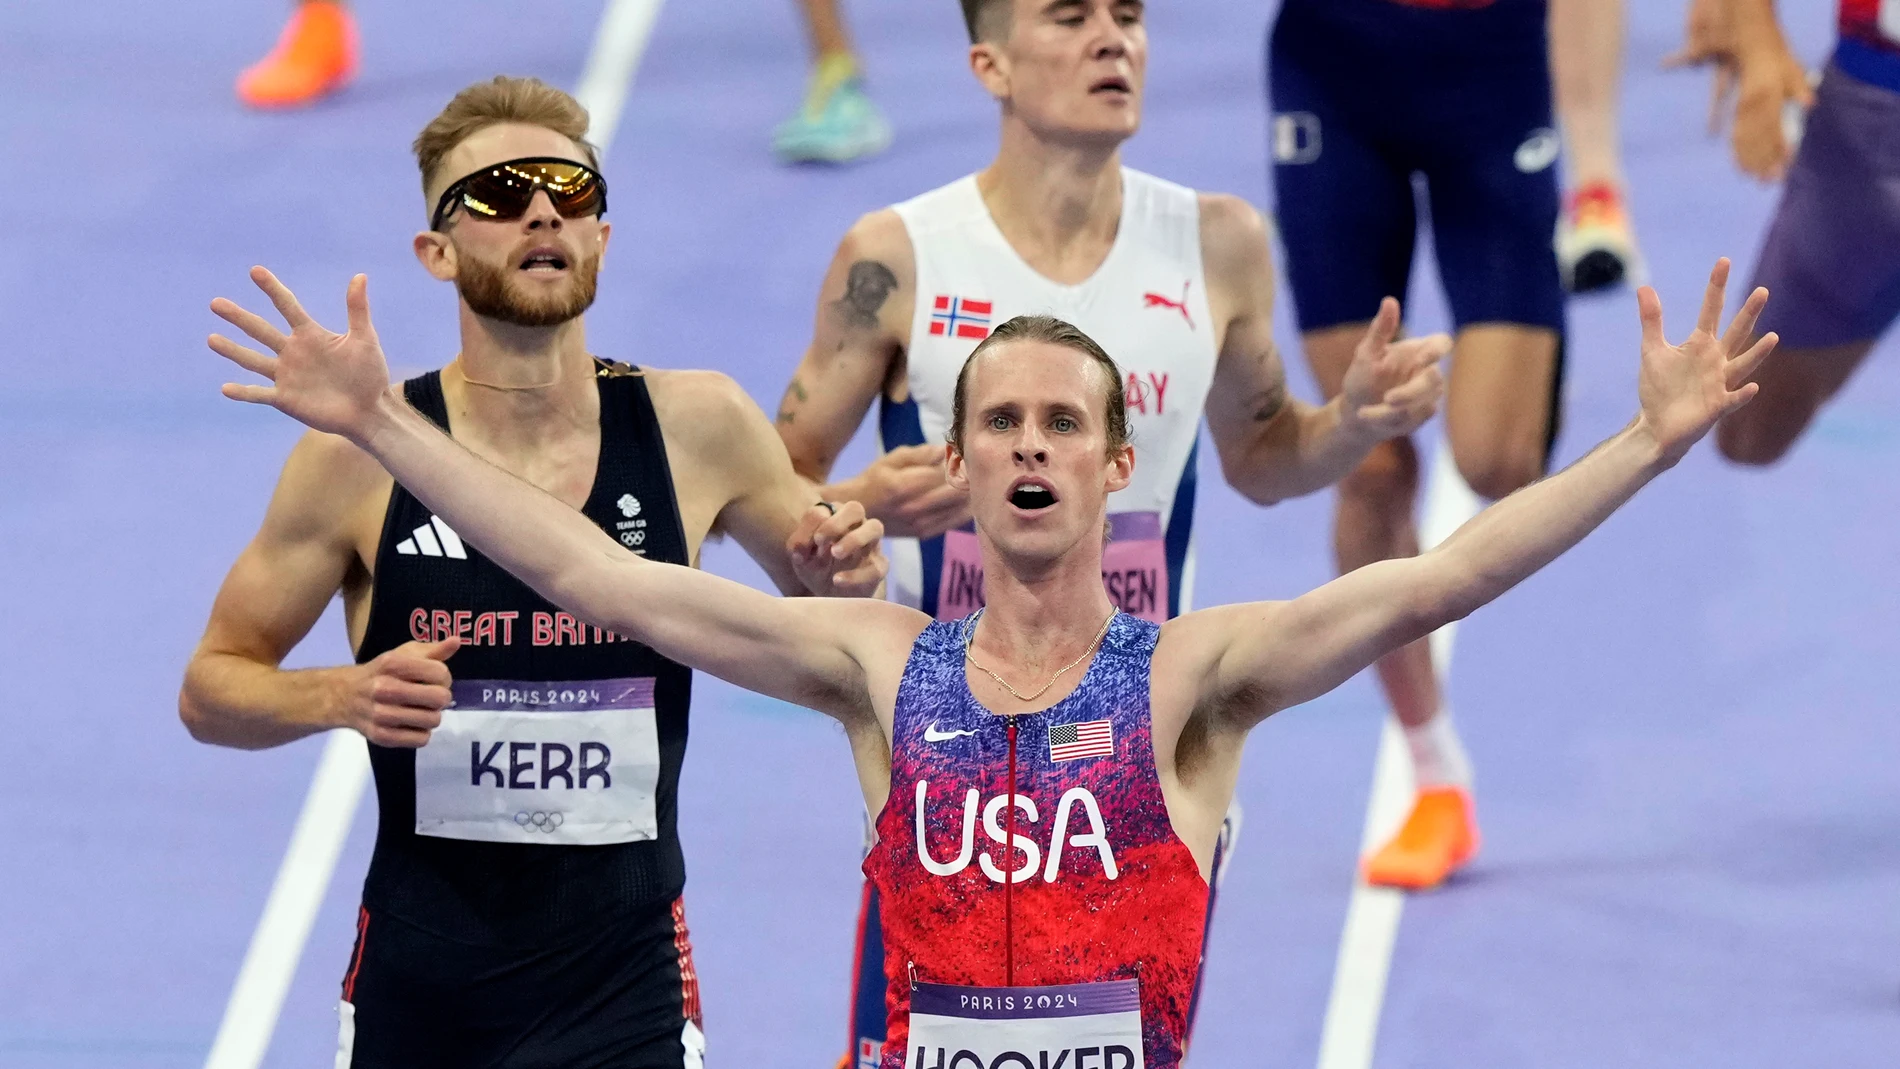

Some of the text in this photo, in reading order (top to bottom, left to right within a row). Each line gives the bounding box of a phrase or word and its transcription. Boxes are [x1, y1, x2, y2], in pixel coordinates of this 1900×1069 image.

[616, 519, 647, 530] TEAM GB
[409, 607, 520, 646] GREAT
[547, 689, 600, 705] 2024
[471, 741, 612, 790] KERR
[915, 779, 1119, 884] USA
[1023, 994, 1077, 1011] 2024
